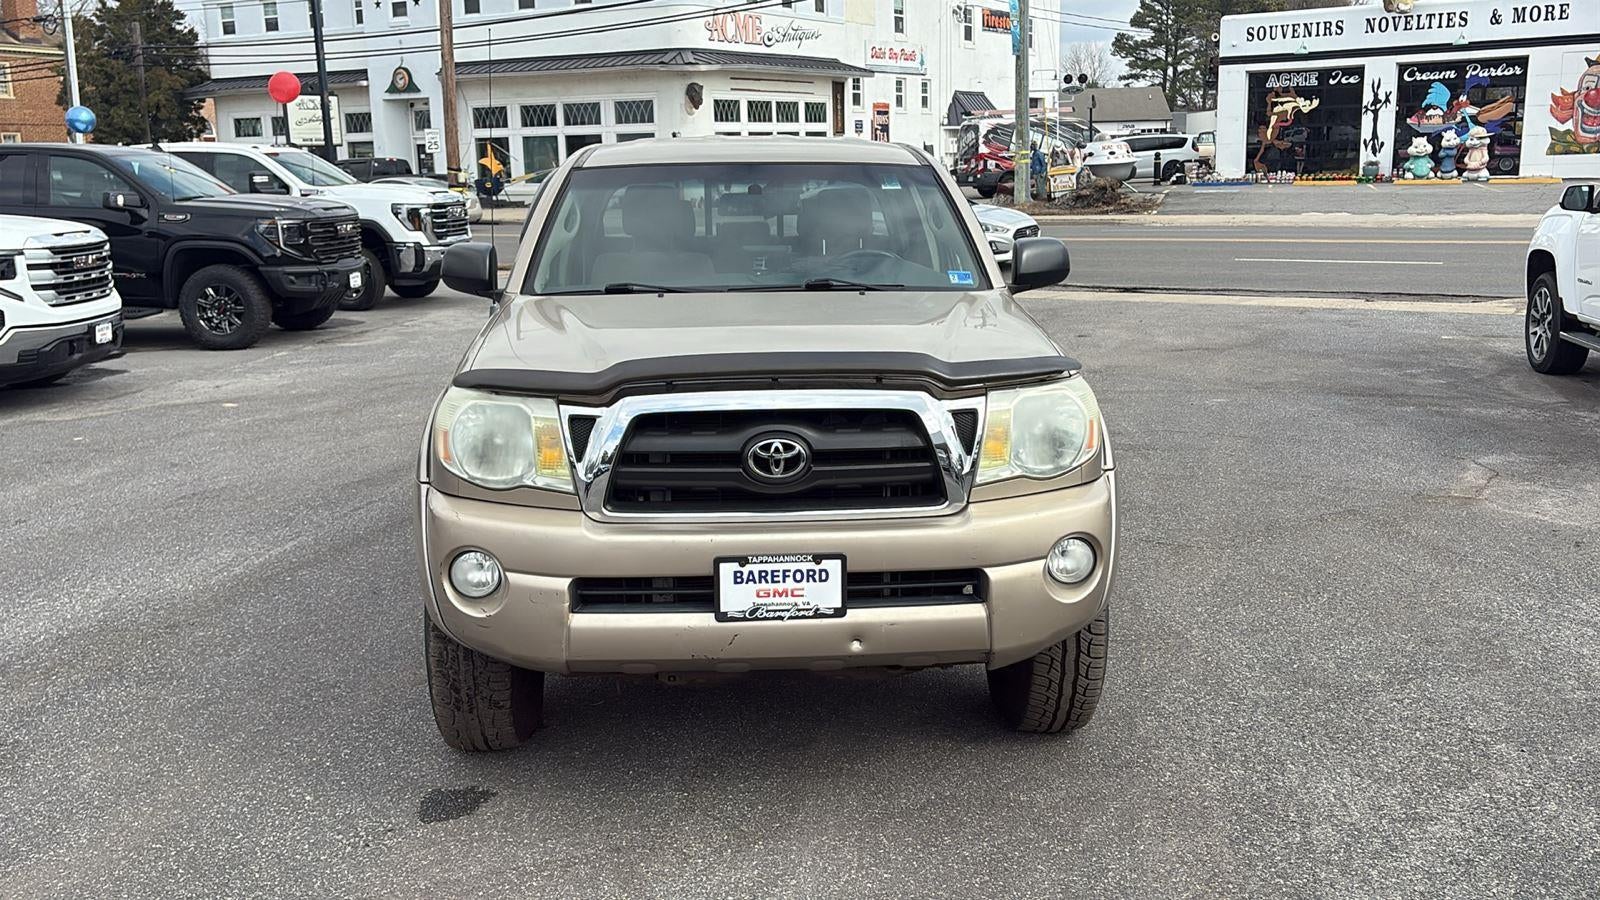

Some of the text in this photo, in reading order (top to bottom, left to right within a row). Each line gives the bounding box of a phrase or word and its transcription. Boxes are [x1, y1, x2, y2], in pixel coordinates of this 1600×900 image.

[704, 12, 822, 49] ACME Antiques
[1246, 3, 1570, 42] SOUVENIRS NOVELTIES & MORE
[888, 47, 899, 63] Boy
[1266, 70, 1361, 88] ACME Ice
[1403, 63, 1525, 82] Cream Parlor
[427, 141, 440, 150] 25
[748, 554, 813, 564] TAPPAHANNOCK
[733, 568, 830, 585] BAREFORD
[755, 587, 805, 599] GMC
[745, 604, 819, 622] Bareford
